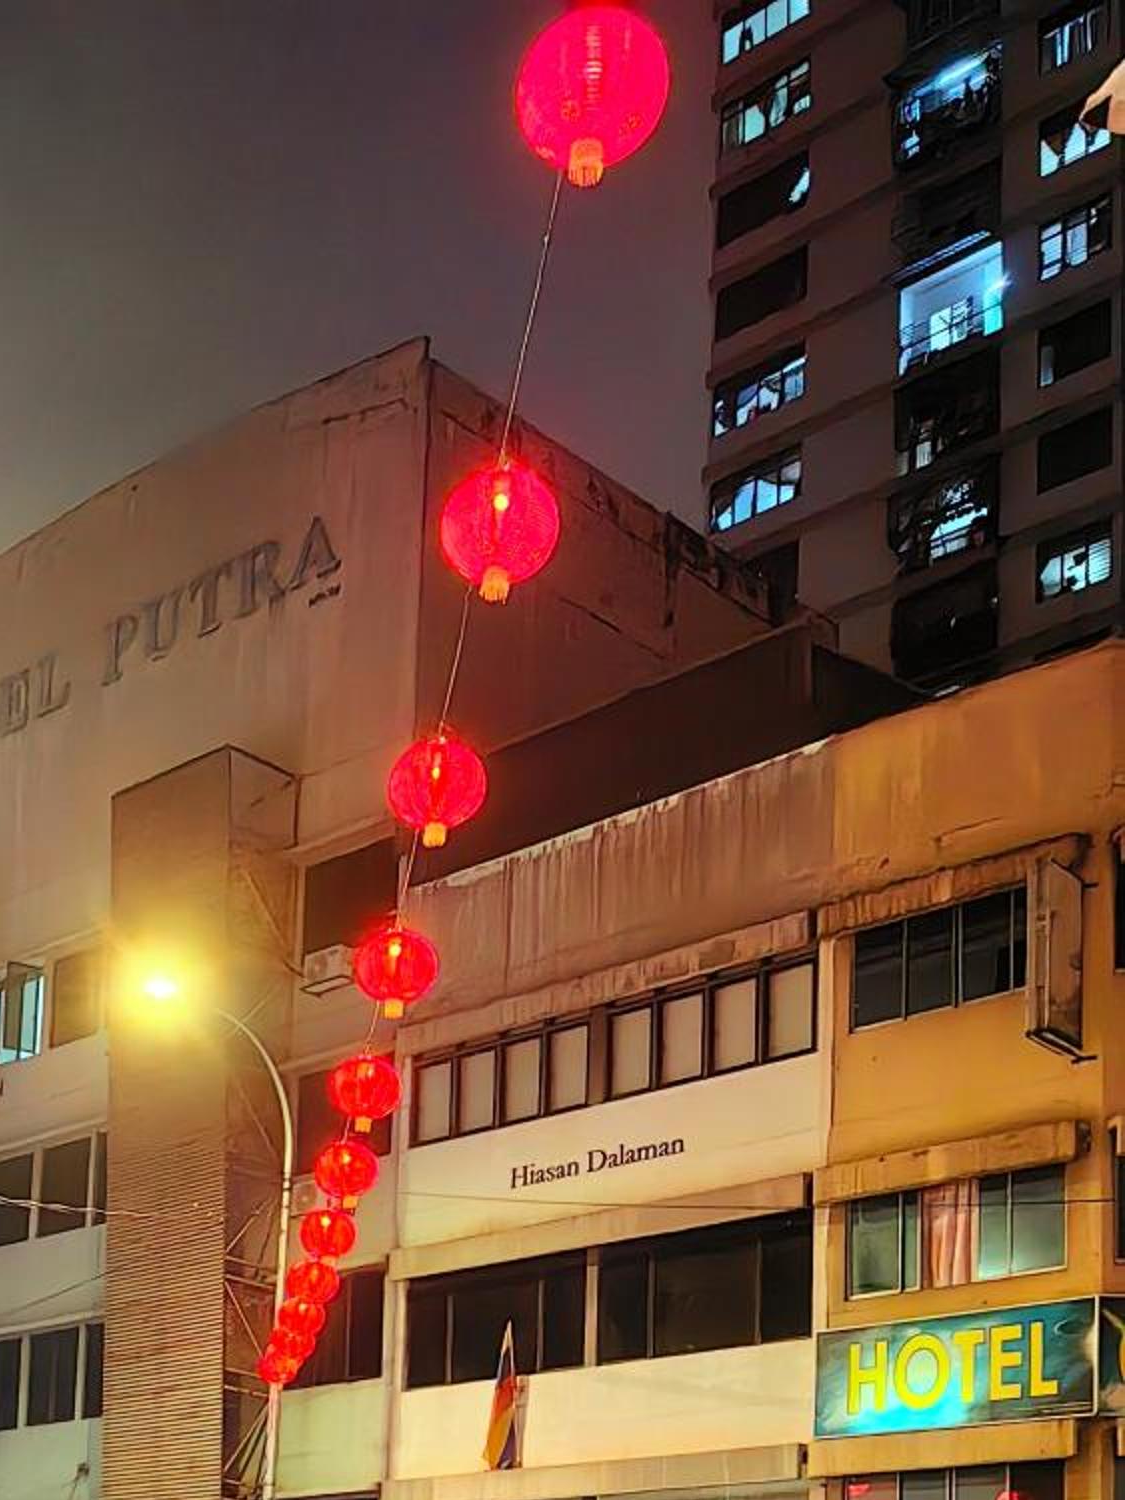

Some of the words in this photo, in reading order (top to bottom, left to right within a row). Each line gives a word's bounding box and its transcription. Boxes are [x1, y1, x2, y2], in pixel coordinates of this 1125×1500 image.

[101, 515, 342, 687] PUTRA
[510, 1160, 580, 1190] Hiasan
[586, 1137, 685, 1173] Dalaman
[846, 1320, 1060, 1416] HOTEL
